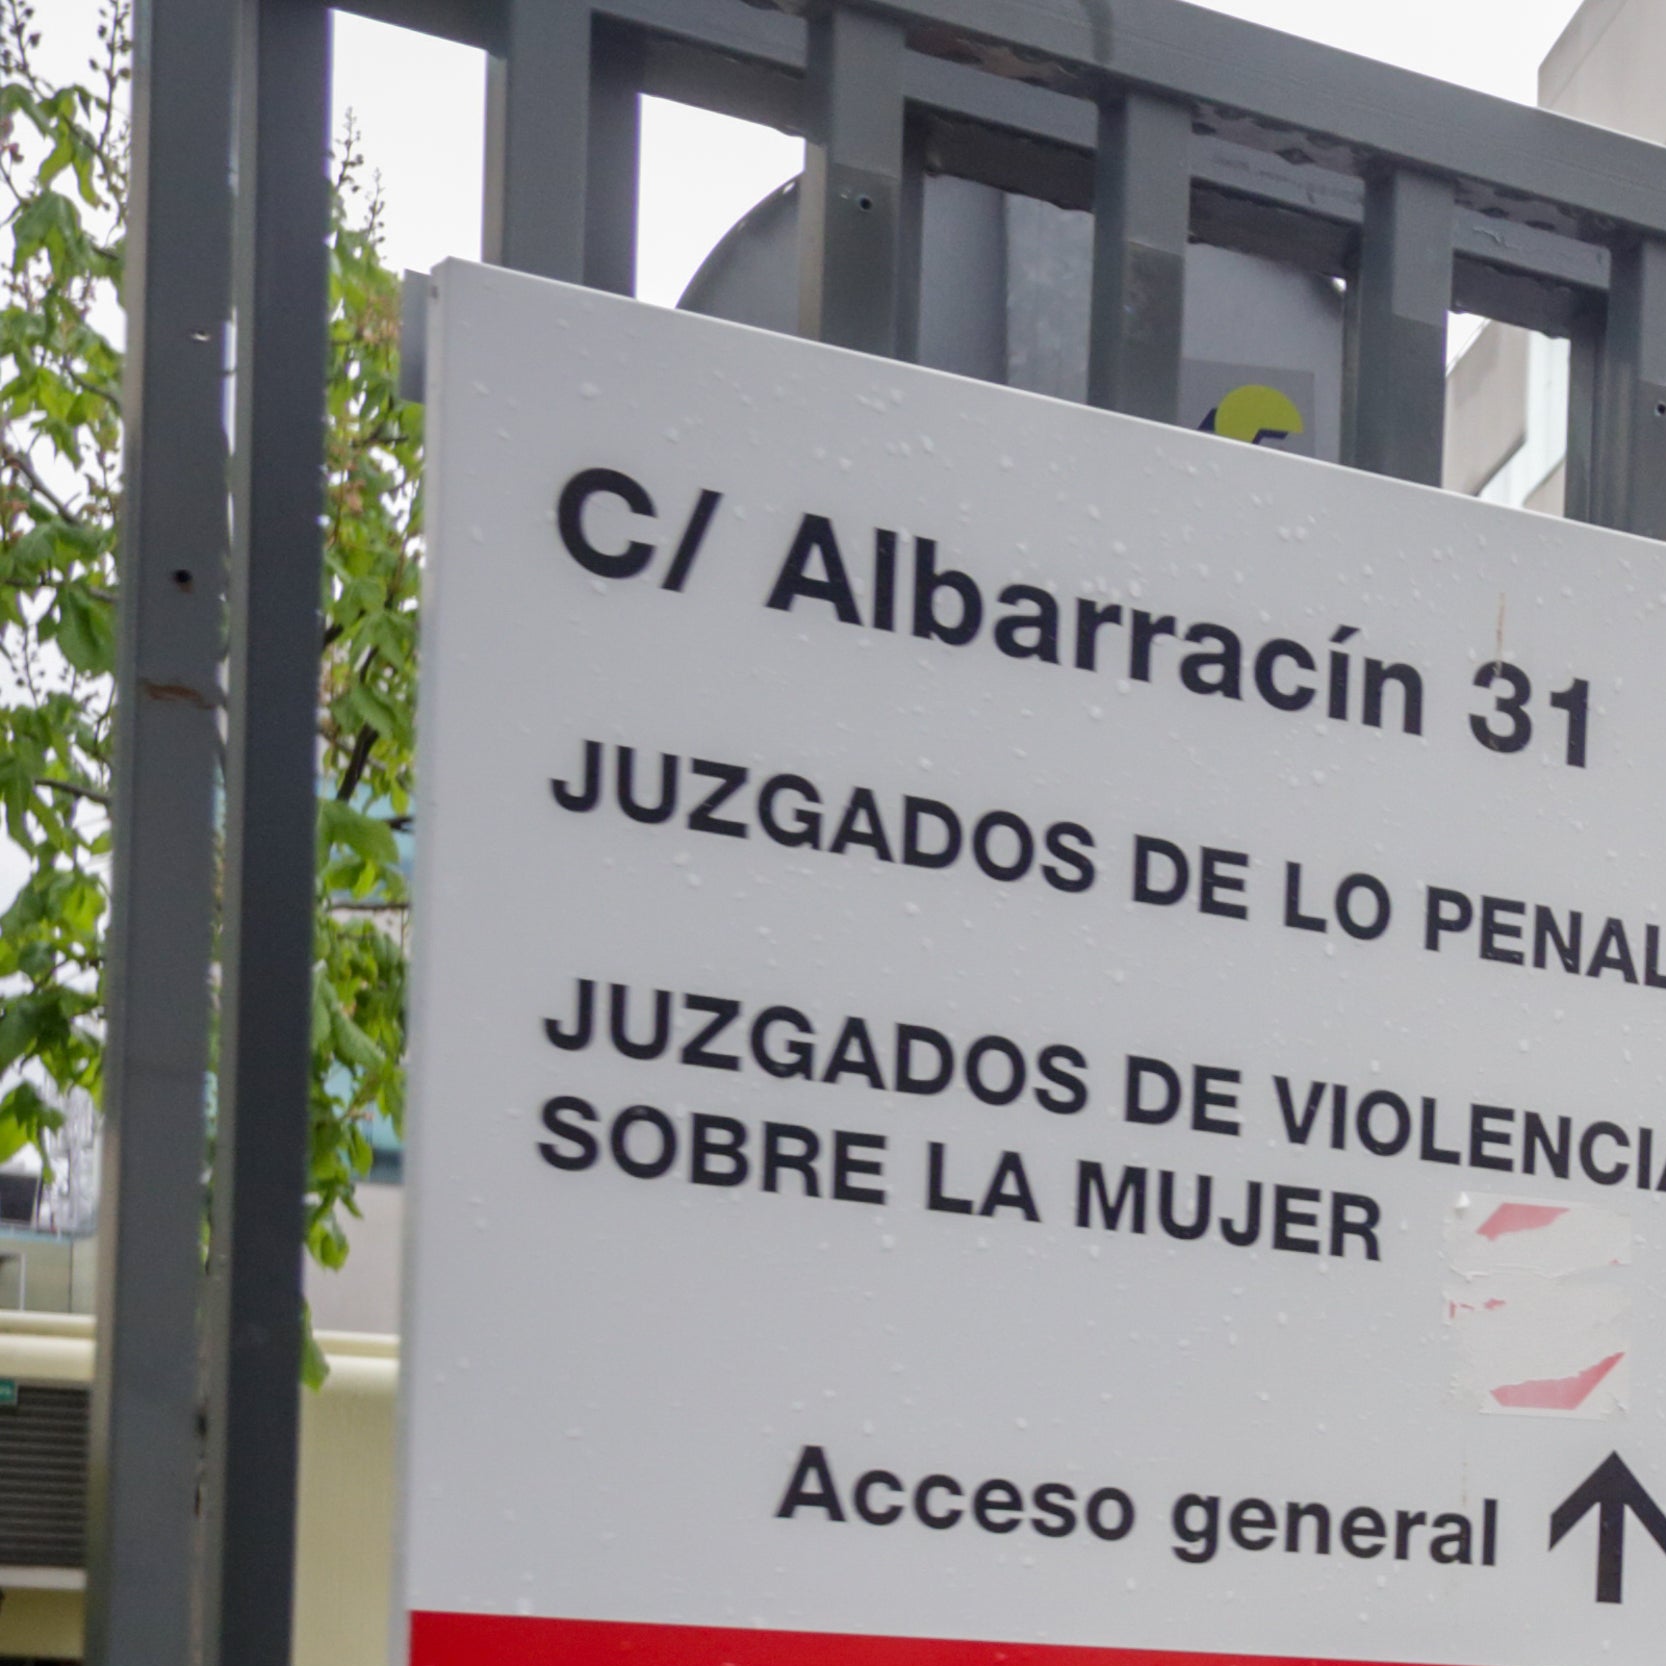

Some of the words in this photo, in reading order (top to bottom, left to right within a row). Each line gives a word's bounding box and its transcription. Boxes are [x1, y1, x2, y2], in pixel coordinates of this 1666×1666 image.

[555, 467, 724, 593] C/
[763, 511, 1424, 737] Albarracín
[1468, 661, 1590, 768] 31
[549, 739, 1097, 894] JUZGADOS
[1131, 834, 1250, 921] DE
[1283, 861, 1392, 942] LO
[542, 977, 1090, 1116] JUZGADOS
[1123, 1055, 1242, 1137] DE
[536, 1095, 888, 1206] SOBRE
[925, 1141, 1042, 1223] LA
[1074, 1159, 1382, 1262] MUJER
[774, 1444, 1136, 1543] Acceso
[1171, 1494, 1499, 1566] general
